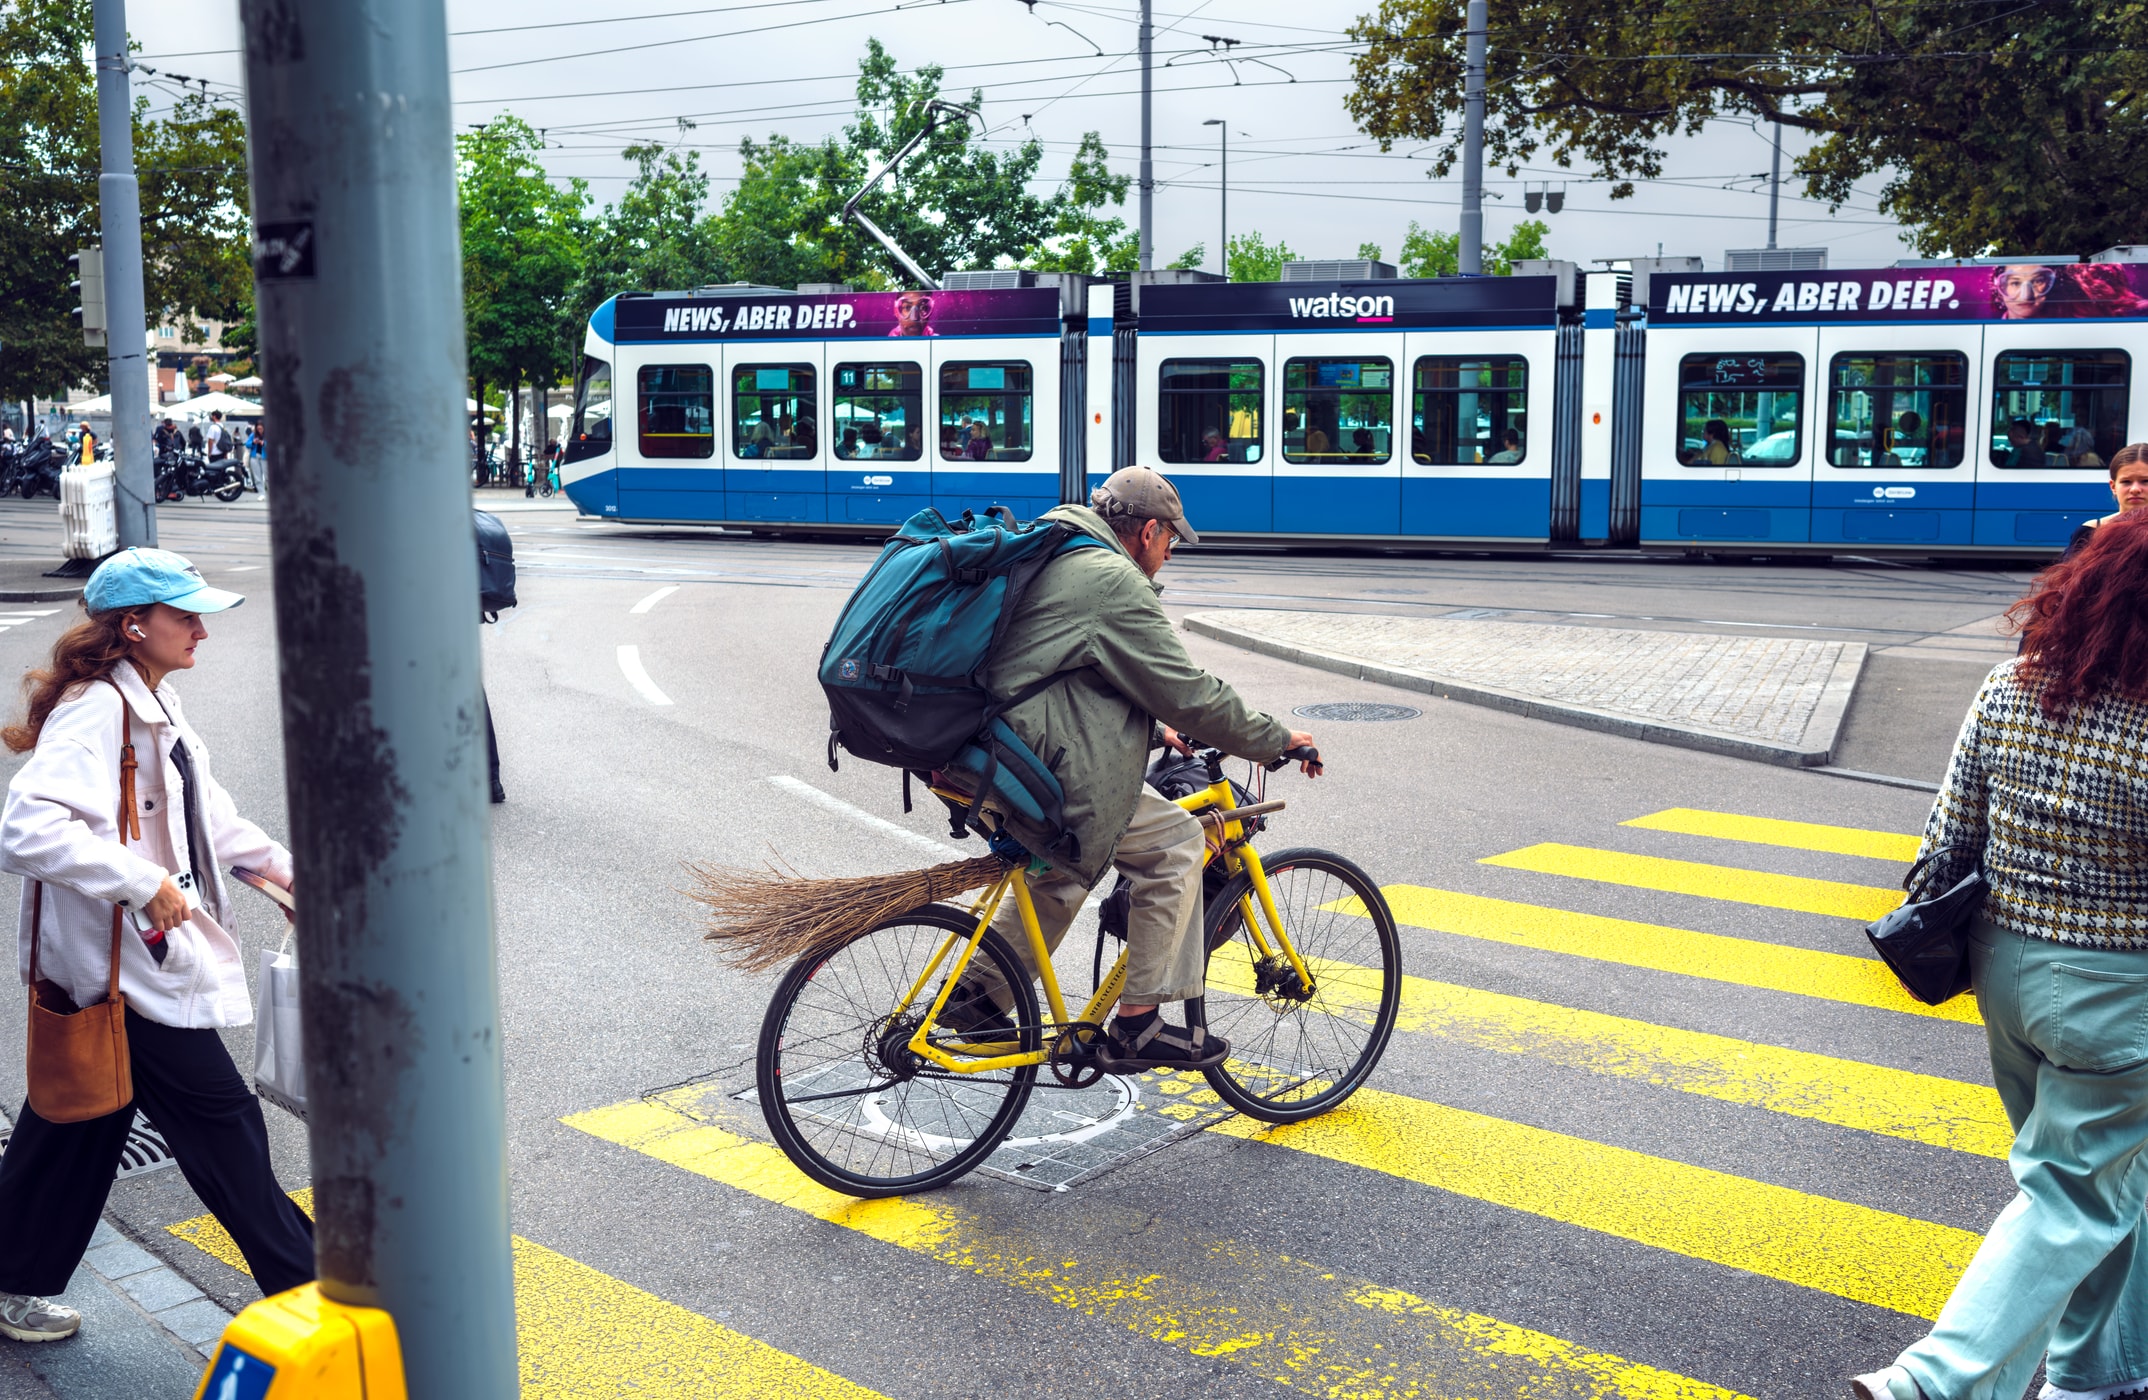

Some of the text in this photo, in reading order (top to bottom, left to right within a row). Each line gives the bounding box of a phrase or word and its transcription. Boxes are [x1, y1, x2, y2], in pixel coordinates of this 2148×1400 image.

[1289, 292, 1394, 318] watson
[1666, 280, 1960, 315] NEWS, ABER DEEP.
[663, 303, 857, 333] NEWS, ABER DEEP.
[843, 371, 854, 384] 11
[1089, 963, 1127, 1016] MTB CYCLETECH
